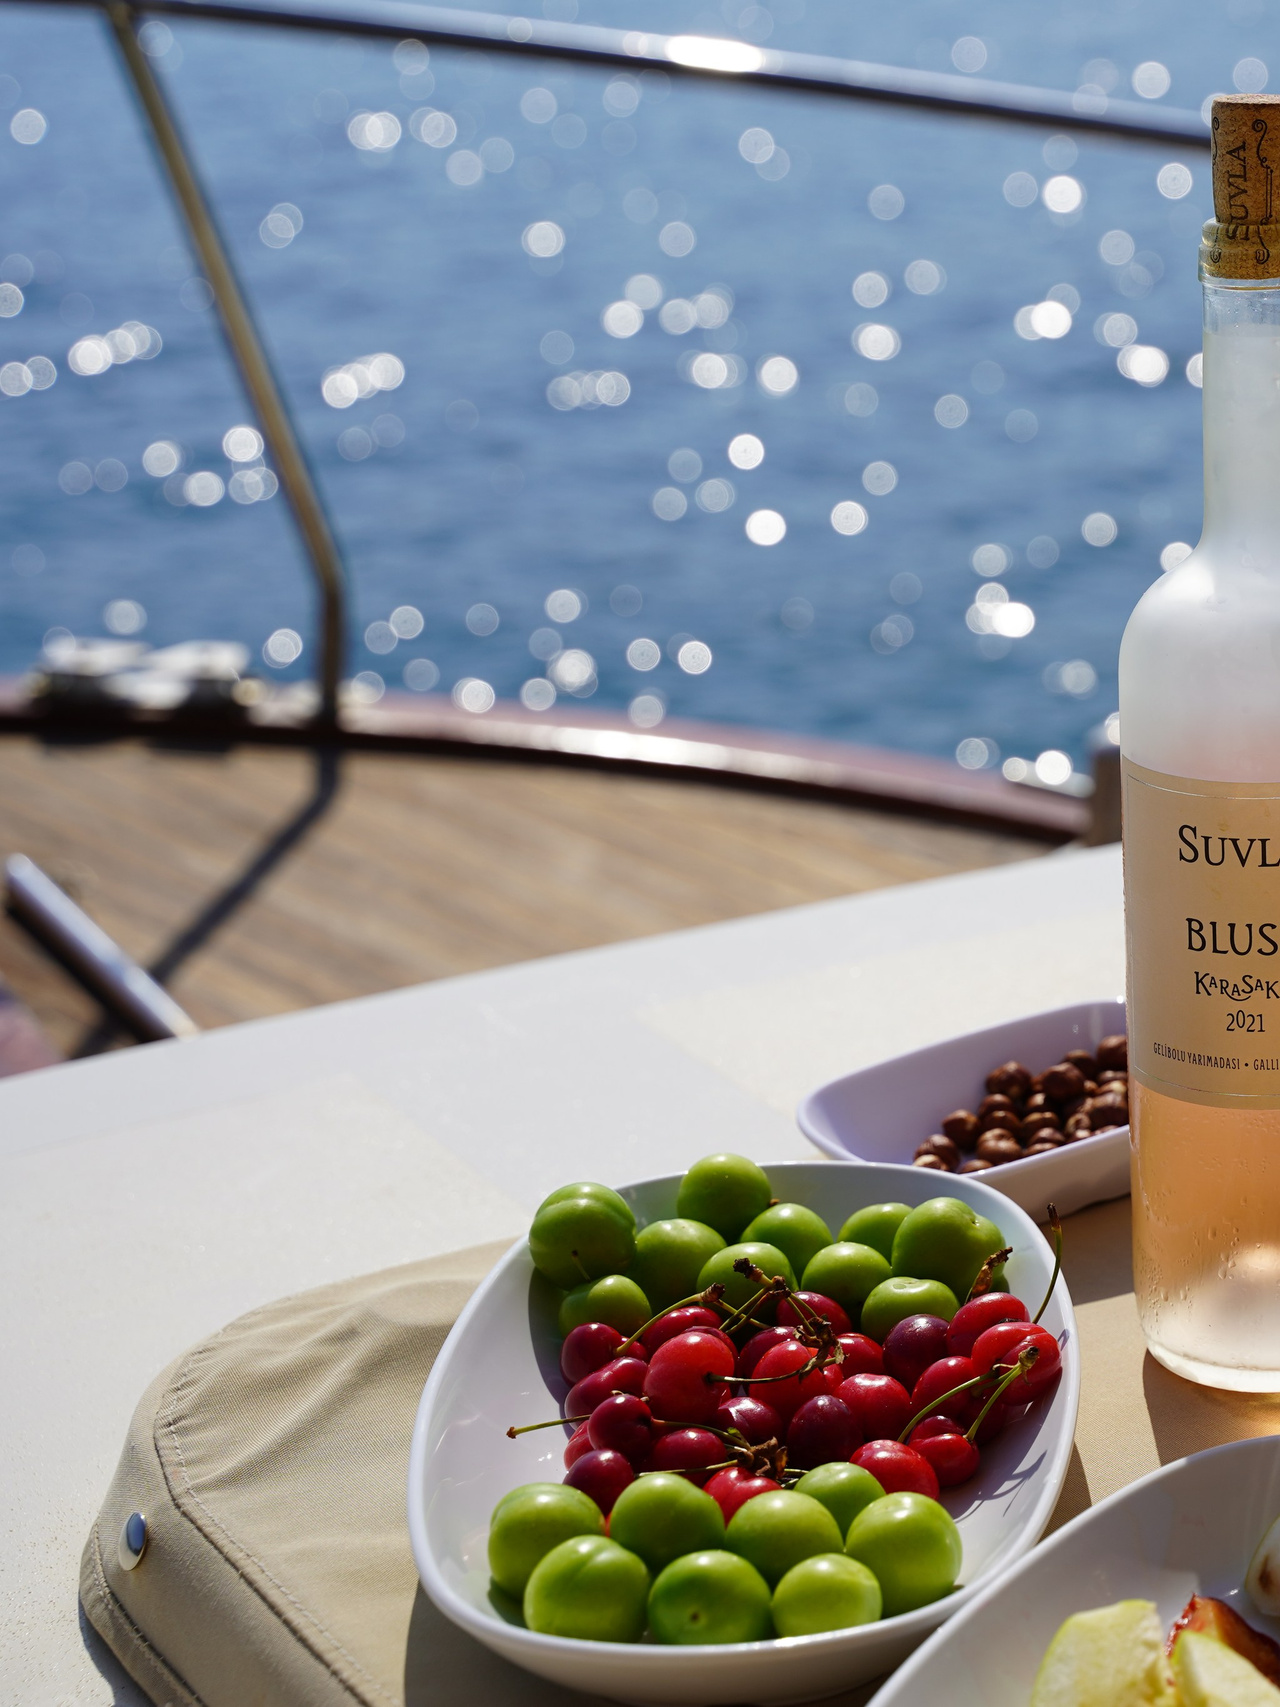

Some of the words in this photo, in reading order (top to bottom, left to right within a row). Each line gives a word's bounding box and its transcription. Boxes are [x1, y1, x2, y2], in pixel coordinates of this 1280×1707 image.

[1226, 140, 1250, 241] SUVLA
[1226, 1009, 1266, 1033] 2021
[1187, 1052, 1240, 1070] YARIMADASI
